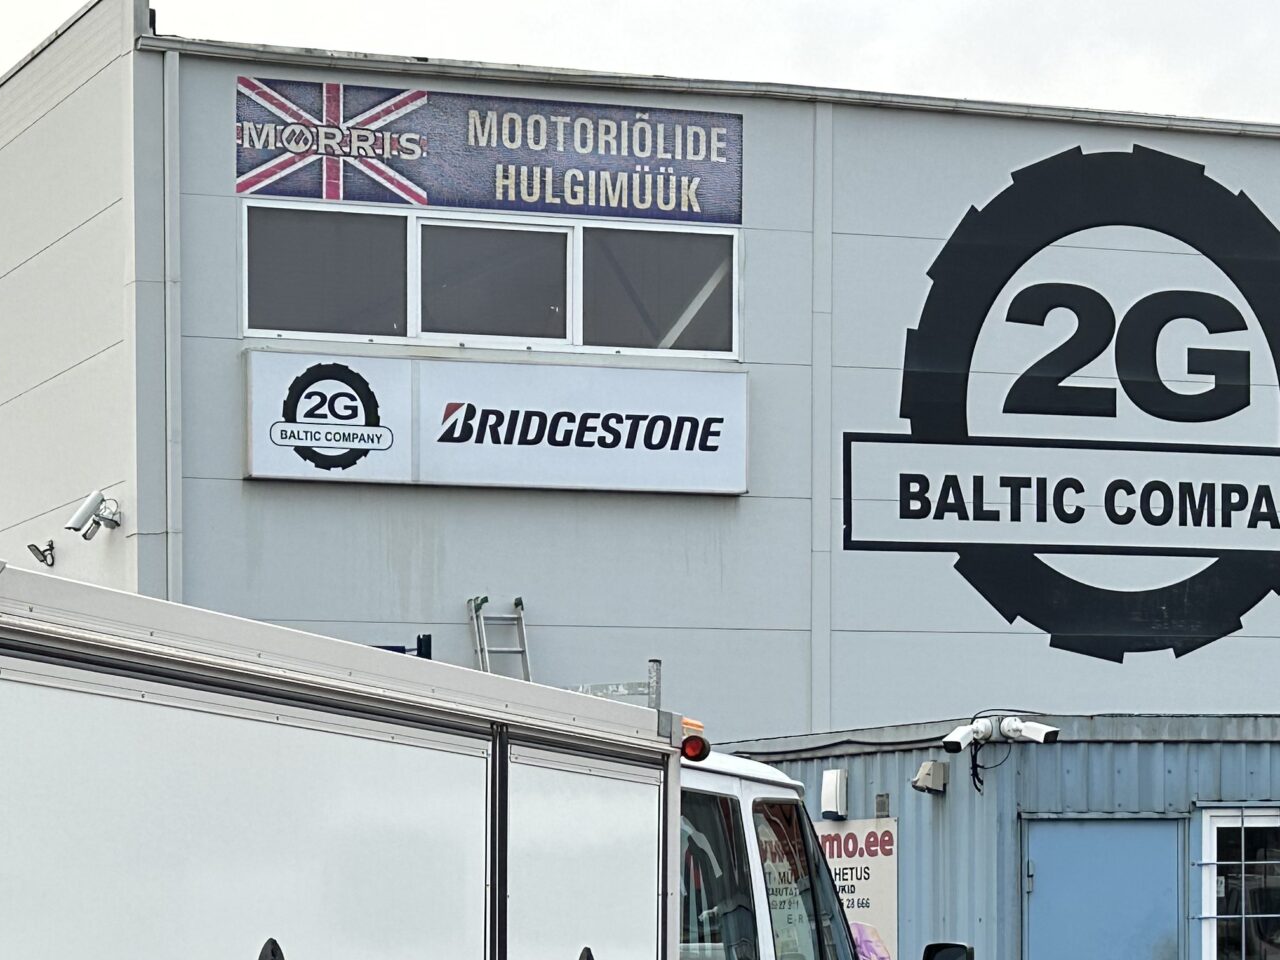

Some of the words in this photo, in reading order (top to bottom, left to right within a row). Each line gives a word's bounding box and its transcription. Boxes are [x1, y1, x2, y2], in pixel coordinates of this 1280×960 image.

[242, 121, 424, 161] MORRIS
[467, 110, 727, 162] MOOTORIÕLIDE
[495, 164, 702, 213] HULGIMÜÜK
[1001, 282, 1251, 423] 2G
[303, 391, 359, 421] 2G
[436, 402, 724, 452] BRIDGESTONE
[280, 428, 321, 443] BALTIC
[323, 430, 383, 446] COMPANY
[898, 473, 1086, 525] BALTIC
[1104, 478, 1280, 529] COMPA
[820, 829, 895, 859] mo.ee
[833, 866, 871, 882] HETUS
